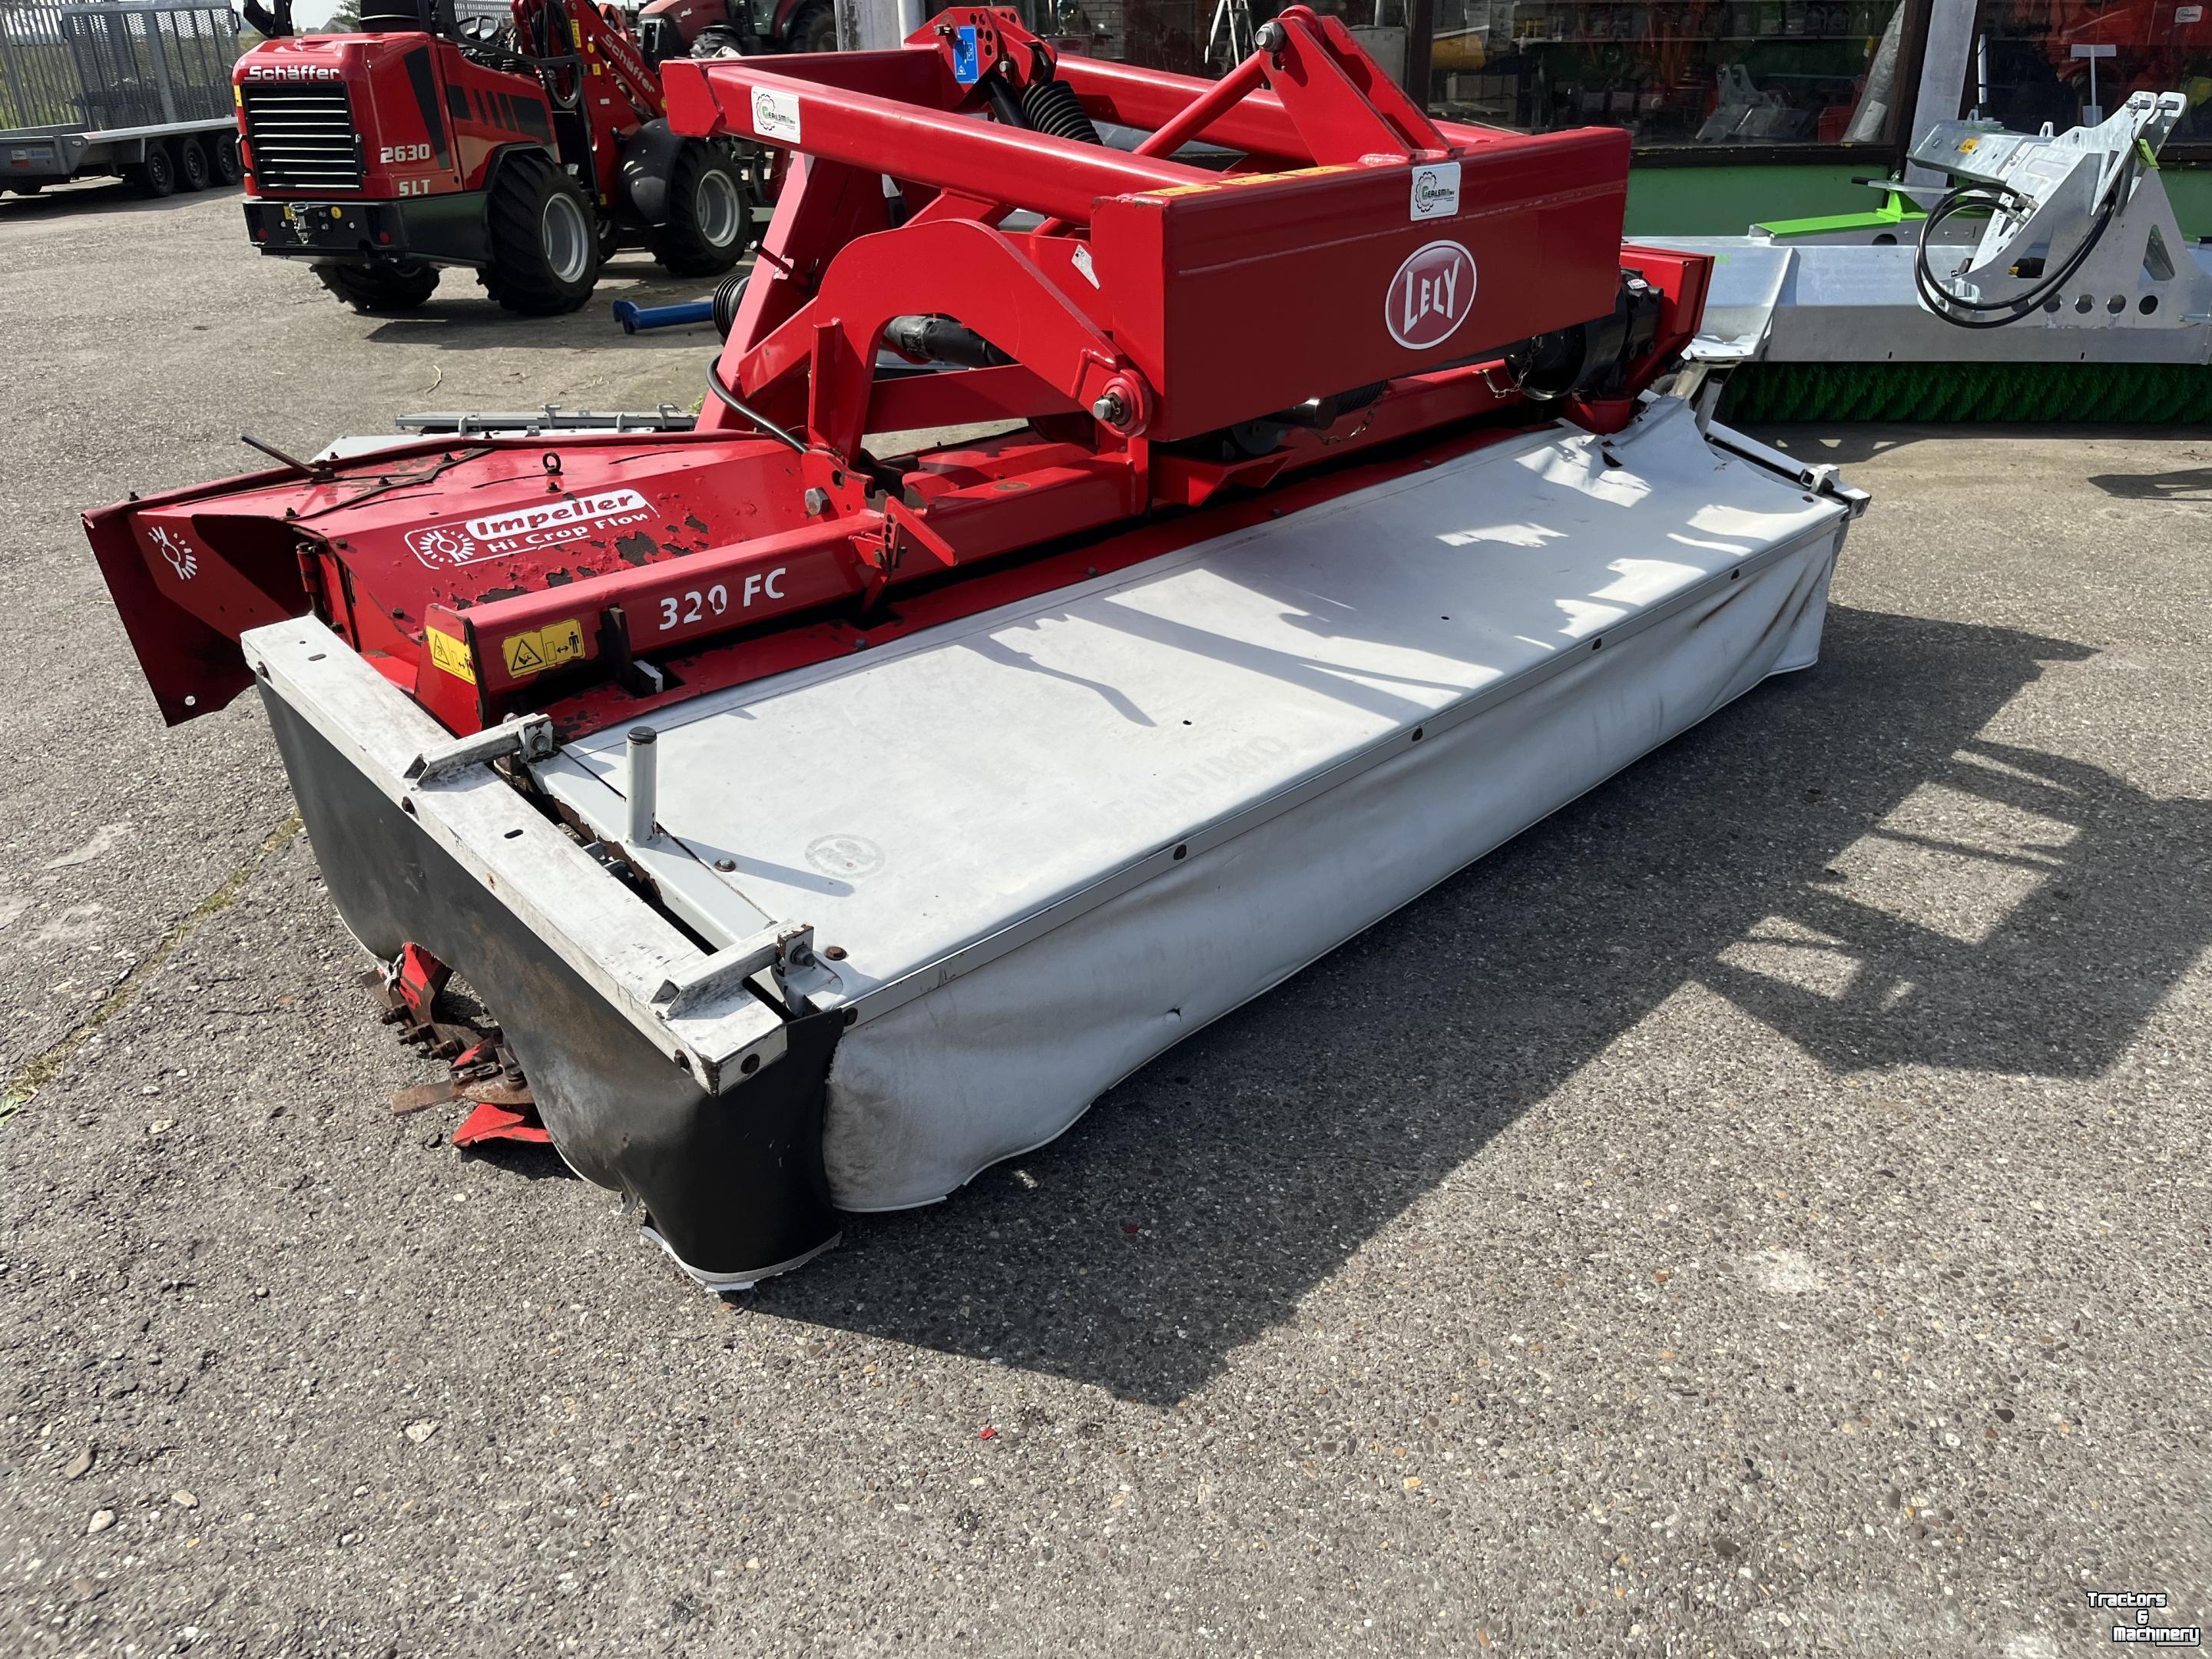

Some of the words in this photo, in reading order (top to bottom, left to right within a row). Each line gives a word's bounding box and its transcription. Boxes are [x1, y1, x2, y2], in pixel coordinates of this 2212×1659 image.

[244, 65, 339, 81] Schäffer
[601, 34, 655, 92] Schäffer
[380, 143, 430, 164] 2630
[399, 179, 430, 197] SLT
[1403, 256, 1461, 336] LELY
[476, 494, 634, 536] Impeller
[487, 538, 518, 552] Hi
[525, 526, 588, 544] Crop
[594, 512, 648, 529] Flow
[659, 584, 728, 631] 320
[743, 568, 786, 608] FC
